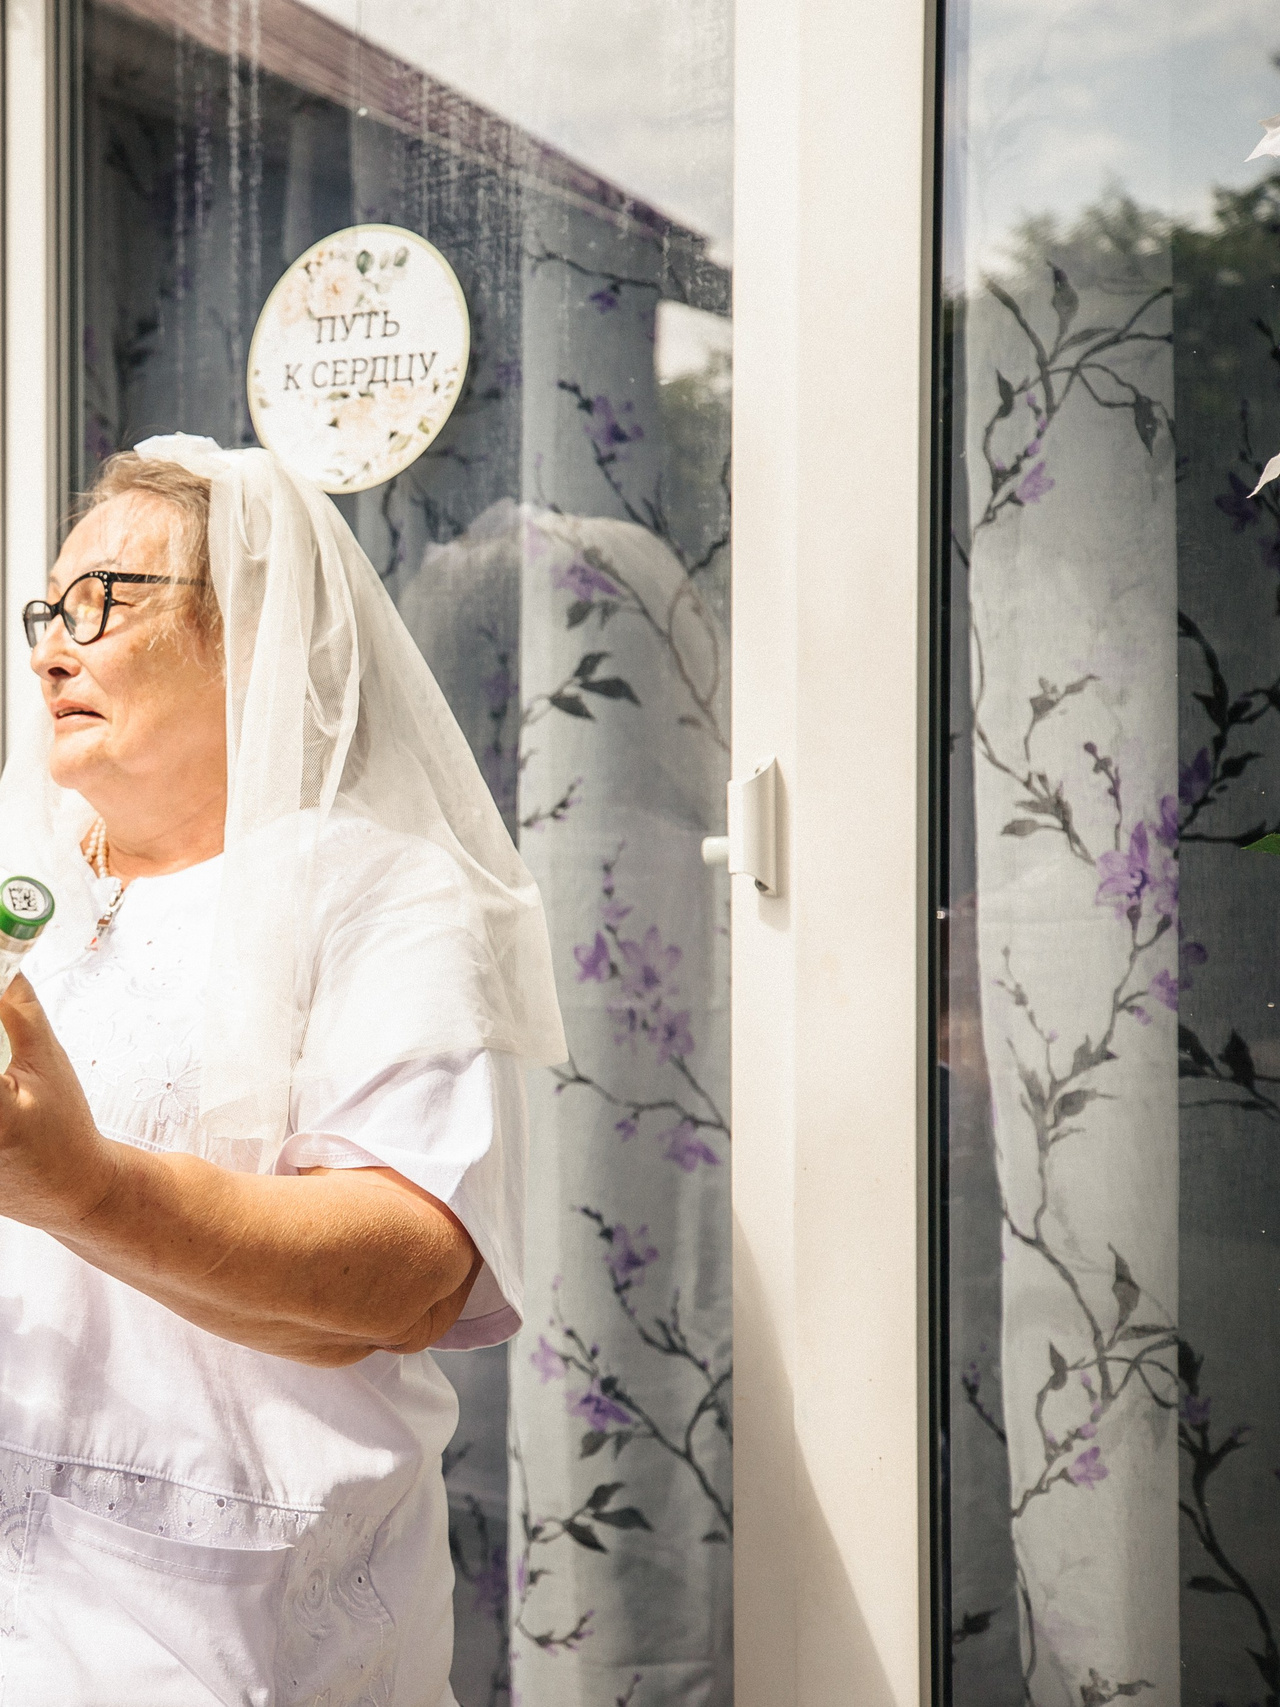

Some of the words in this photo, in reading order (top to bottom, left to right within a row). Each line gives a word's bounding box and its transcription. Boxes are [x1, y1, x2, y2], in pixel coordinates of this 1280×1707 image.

[316, 310, 400, 344] ПУТЬ
[283, 363, 303, 391] К
[311, 351, 438, 389] СЕРДЦУ
